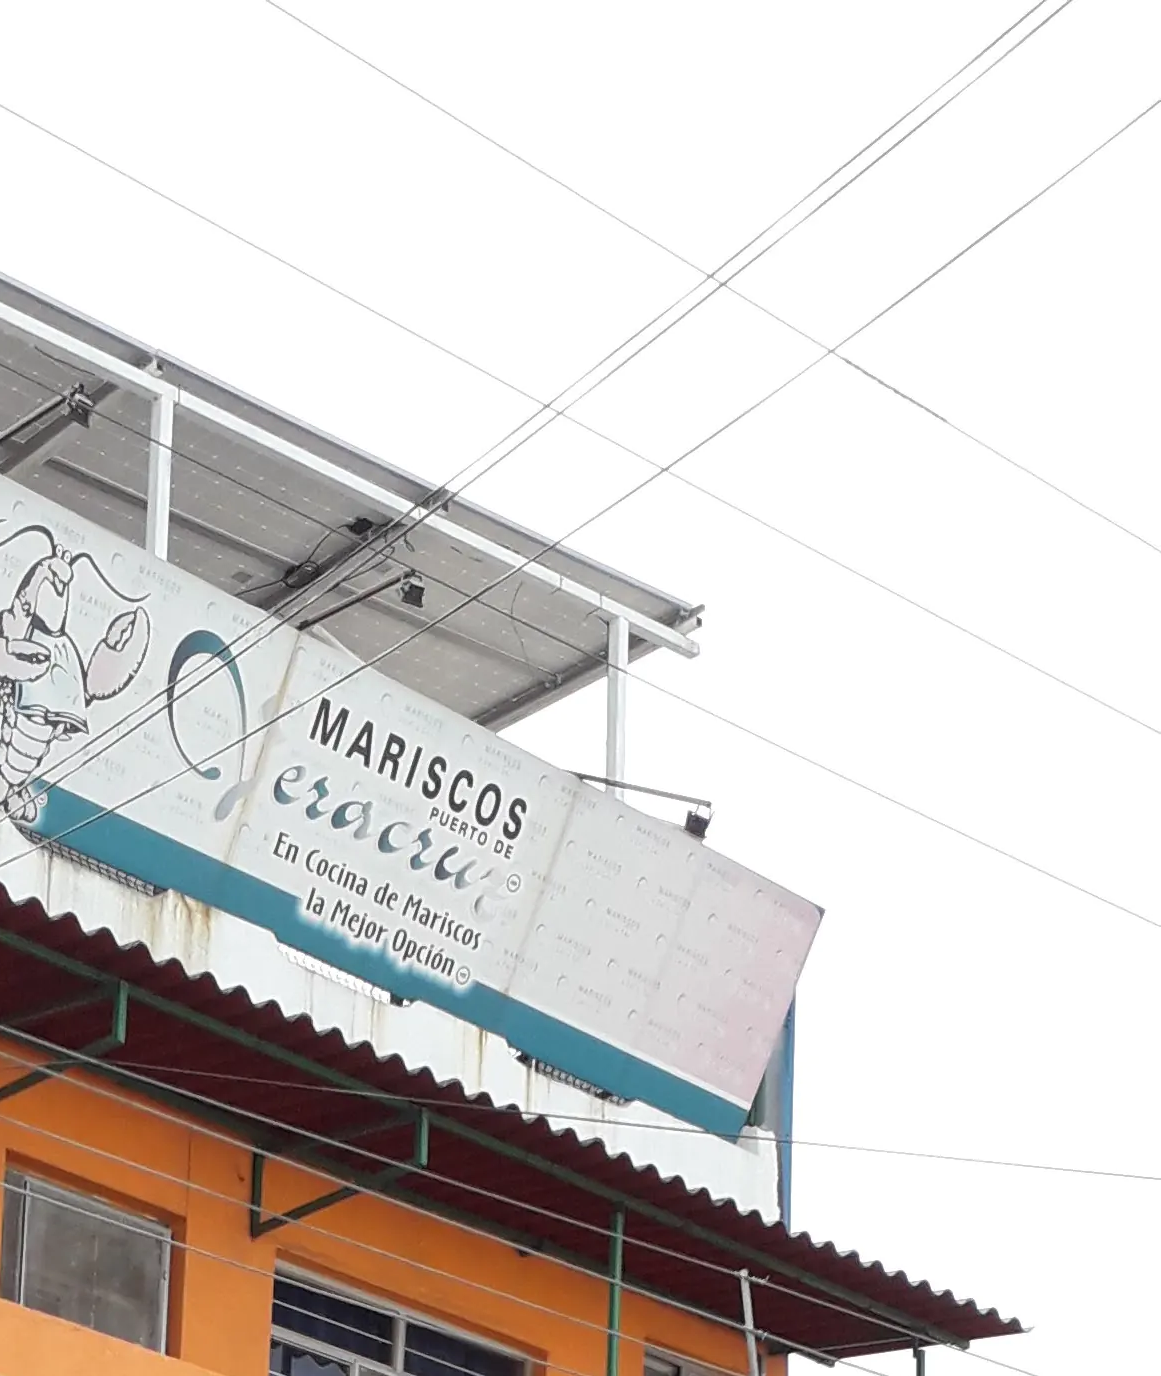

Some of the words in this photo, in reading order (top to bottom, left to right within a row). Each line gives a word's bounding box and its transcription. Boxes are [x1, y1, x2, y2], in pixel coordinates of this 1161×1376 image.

[308, 696, 529, 842] MARISCOS
[427, 806, 489, 848] PUERTO
[492, 838, 516, 861] DE
[272, 830, 300, 867] En
[305, 846, 367, 898] Cocina
[372, 877, 399, 911] de
[403, 895, 482, 952] Mariscos
[305, 888, 326, 916] la
[331, 899, 388, 947] Mejor
[391, 922, 456, 978] Opción
